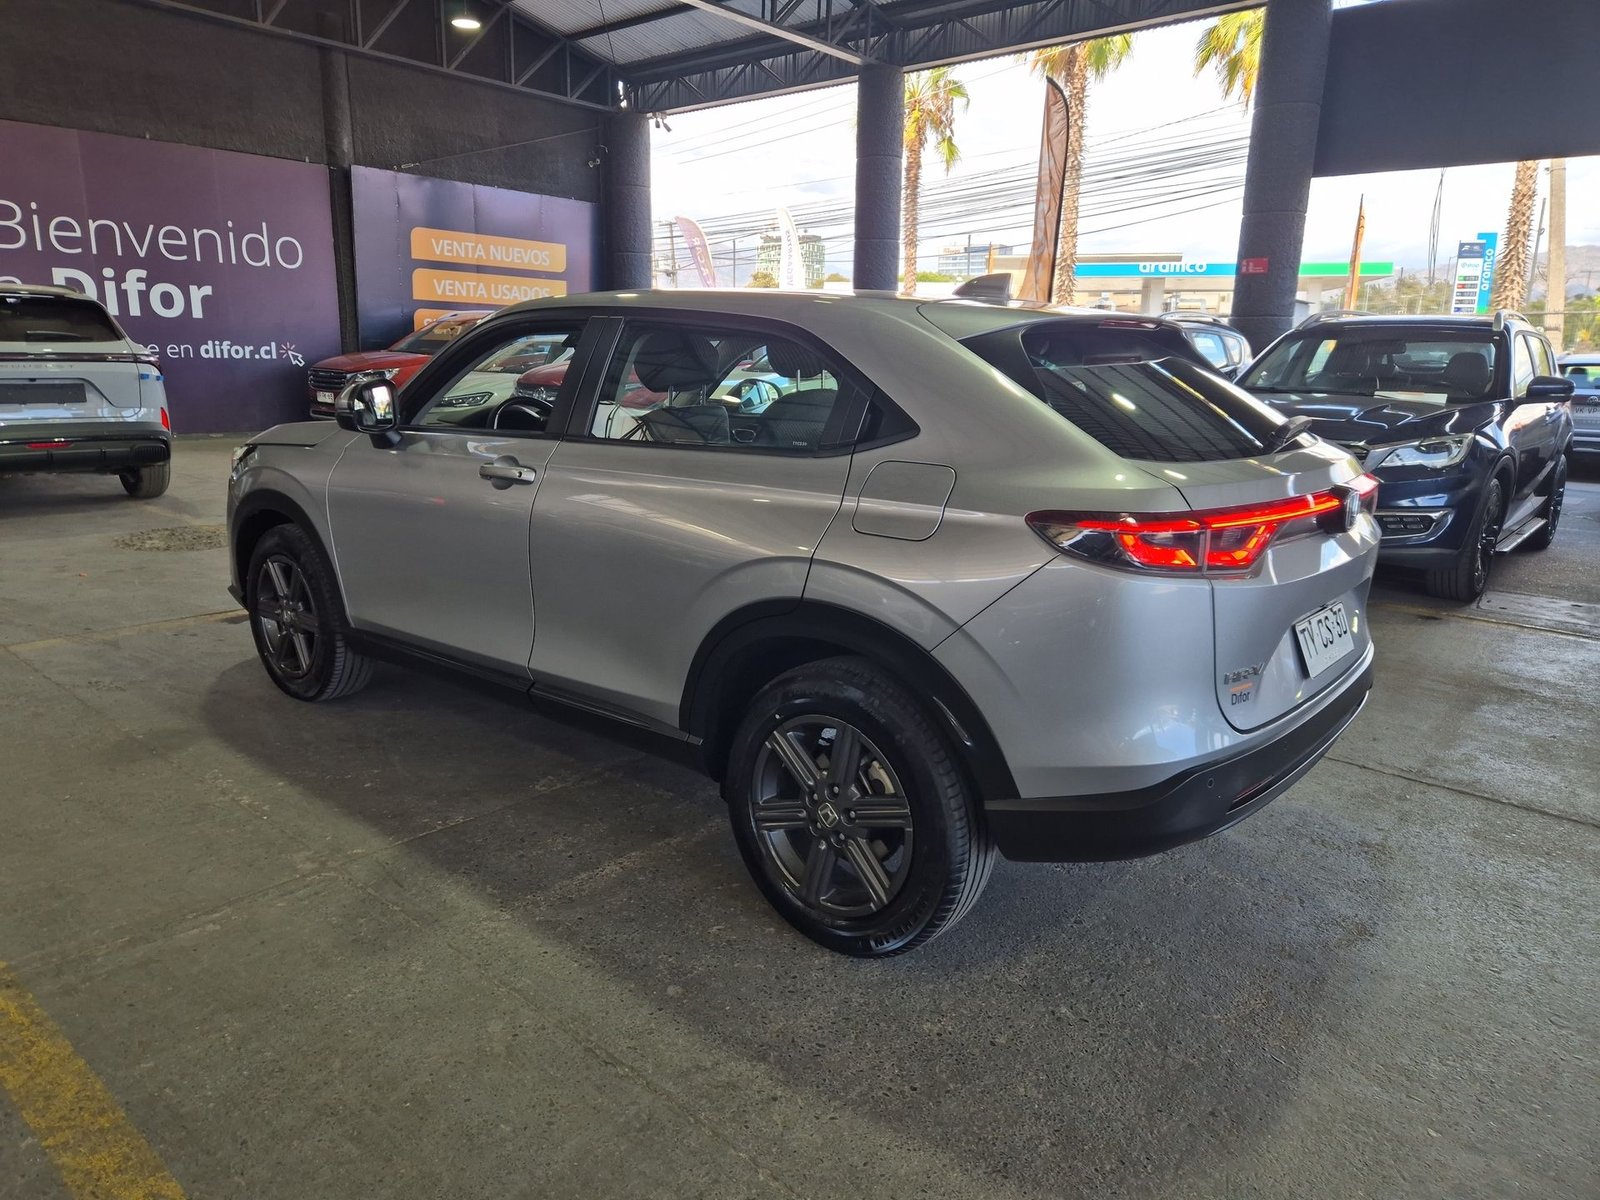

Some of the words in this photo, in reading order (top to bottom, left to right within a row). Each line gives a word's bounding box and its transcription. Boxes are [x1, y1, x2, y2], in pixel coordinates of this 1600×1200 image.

[0, 199, 303, 269] Bienvenido
[432, 238, 486, 260] VENTA
[490, 245, 550, 266] NUEVOS
[1138, 262, 1207, 273] aramco
[1481, 248, 1494, 291] aramco
[51, 267, 213, 319] Difor
[434, 279, 487, 298] VENTA
[491, 284, 550, 300] USADOS
[166, 342, 194, 359] en
[200, 340, 277, 360] difor.cl
